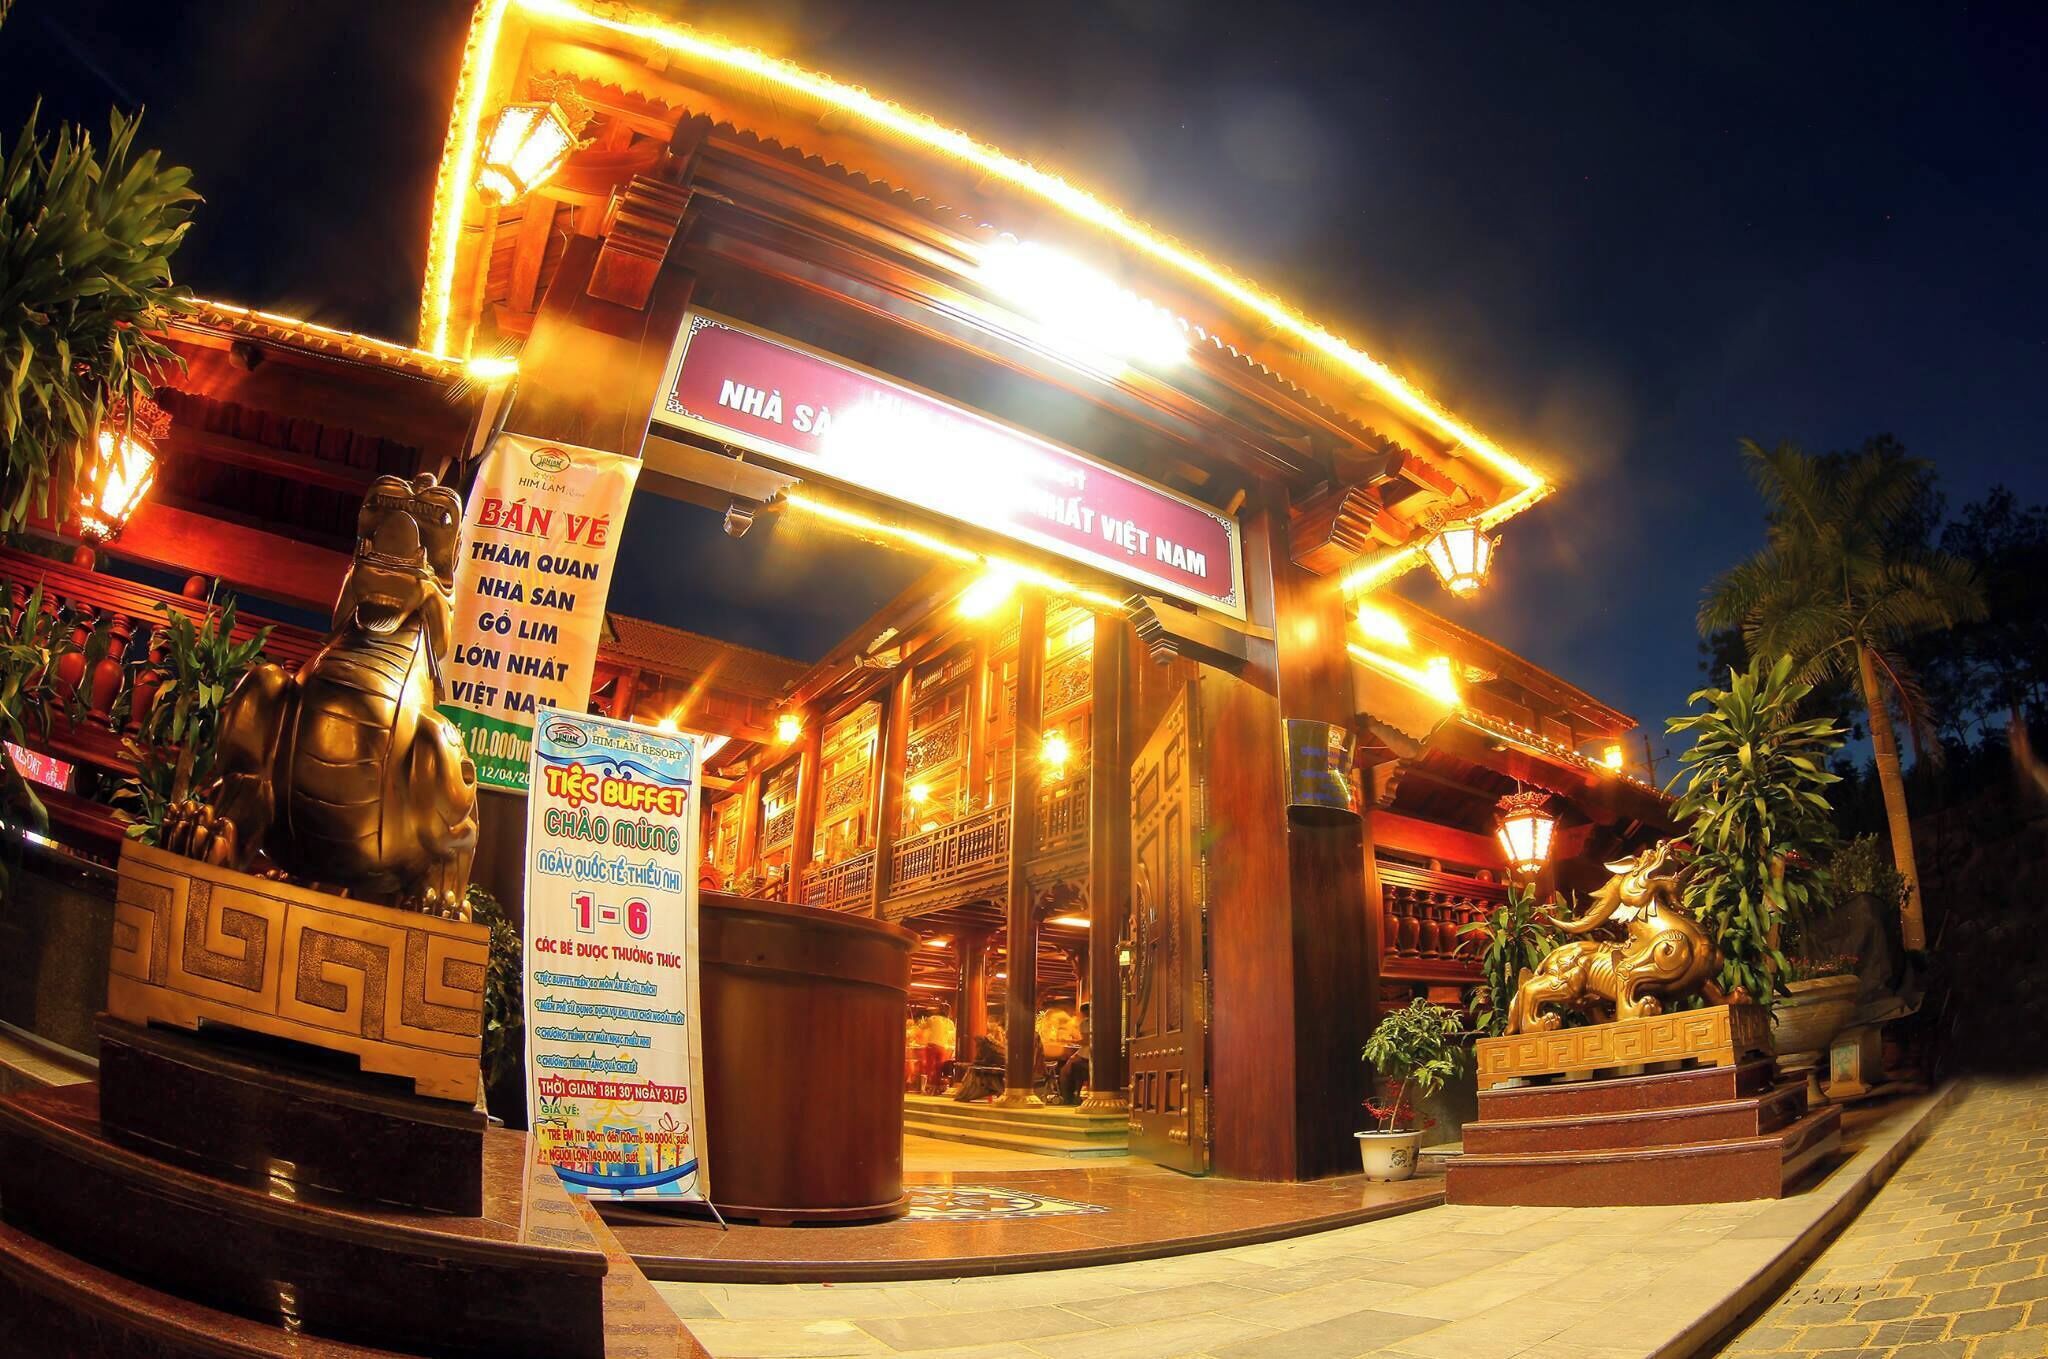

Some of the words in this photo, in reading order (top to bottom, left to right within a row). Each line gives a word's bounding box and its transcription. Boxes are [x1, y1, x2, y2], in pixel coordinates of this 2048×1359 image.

[519, 477, 540, 489] HIM
[542, 482, 566, 493] LAM
[718, 379, 783, 424] NHÀ
[791, 403, 834, 438] SÀ
[1101, 514, 1149, 555] VIỆT
[1155, 536, 1206, 577] NAM
[477, 497, 554, 538] BÁN
[565, 514, 610, 548] VÉ
[471, 542, 530, 569] THĂM
[537, 555, 599, 581] QUAN
[476, 577, 523, 603] NHÀ
[530, 586, 576, 612] SÀN
[478, 609, 512, 635] GỖ
[518, 620, 558, 644] LIM
[454, 642, 501, 670] LỚN
[506, 654, 569, 683] NHẤT
[451, 681, 498, 709] VIỆT
[592, 735, 613, 747] HIM
[616, 740, 640, 752] LAM
[641, 745, 682, 761] RESORT
[545, 763, 598, 807] TIỆC
[601, 777, 687, 815] BUFFET
[545, 808, 609, 843] CHÀO
[539, 850, 573, 874] NGÀY
[575, 854, 607, 879] QUỐC
[609, 858, 625, 882] TẾ
[627, 861, 661, 886] THIẾU
[662, 871, 680, 890] NHI
[535, 936, 557, 953] CÁC
[560, 939, 574, 956] BÉ
[541, 1078, 566, 1094] THỜI
[568, 1081, 597, 1096] GIAN:
[599, 1084, 617, 1097] 18H
[635, 1083, 661, 1100] NGÀY
[663, 1088, 686, 1102] 31/5
[586, 1130, 606, 1142] 90cm
